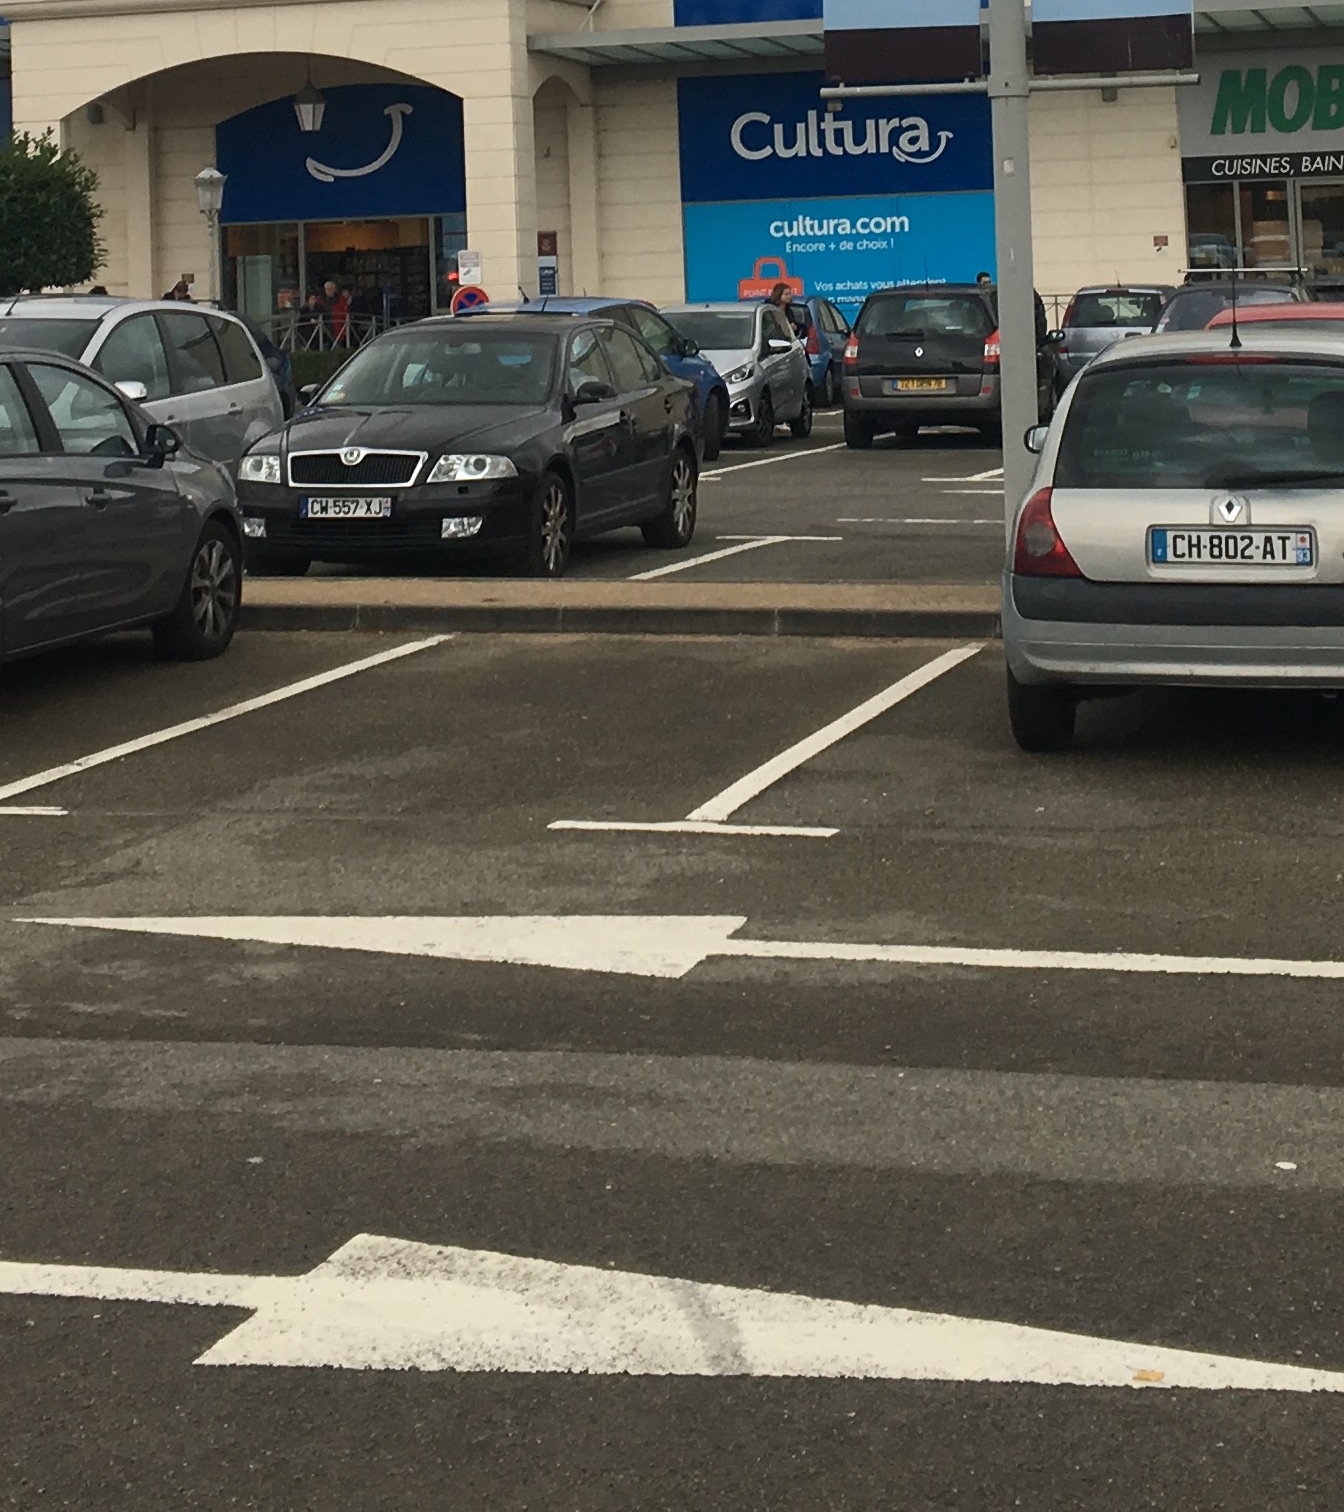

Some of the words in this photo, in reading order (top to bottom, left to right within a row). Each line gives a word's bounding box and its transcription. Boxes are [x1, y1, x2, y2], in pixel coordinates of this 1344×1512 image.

[730, 109, 932, 162] Cultura
[1211, 156, 1295, 176] CUISINES,
[769, 214, 910, 238] cultura.com
[785, 240, 826, 253] Encore
[828, 242, 836, 251] +
[839, 239, 855, 251] de
[856, 238, 889, 251] choix
[813, 280, 834, 292] Vos
[835, 279, 869, 291] achats
[870, 279, 895, 290] vous
[1171, 534, 1292, 560] CH-802-AT
